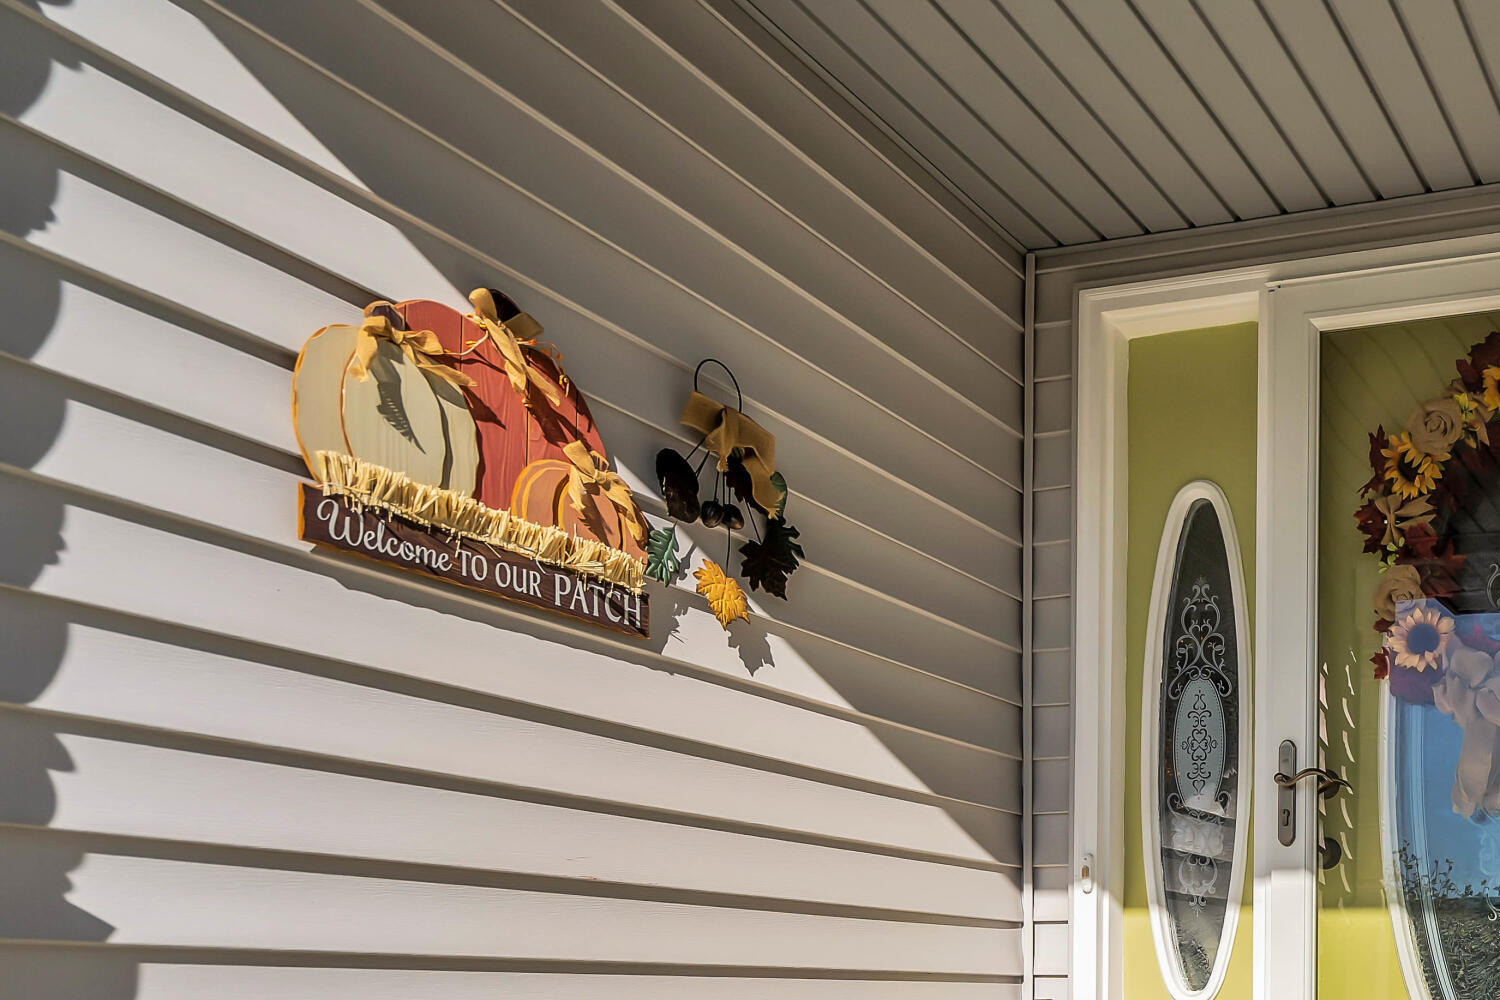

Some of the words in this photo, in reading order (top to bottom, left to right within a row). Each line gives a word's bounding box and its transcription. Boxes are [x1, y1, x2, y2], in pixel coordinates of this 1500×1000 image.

[316, 499, 452, 572] Welcome
[460, 551, 488, 581] TO
[495, 562, 542, 598] OUR
[554, 574, 642, 629] PATCH
